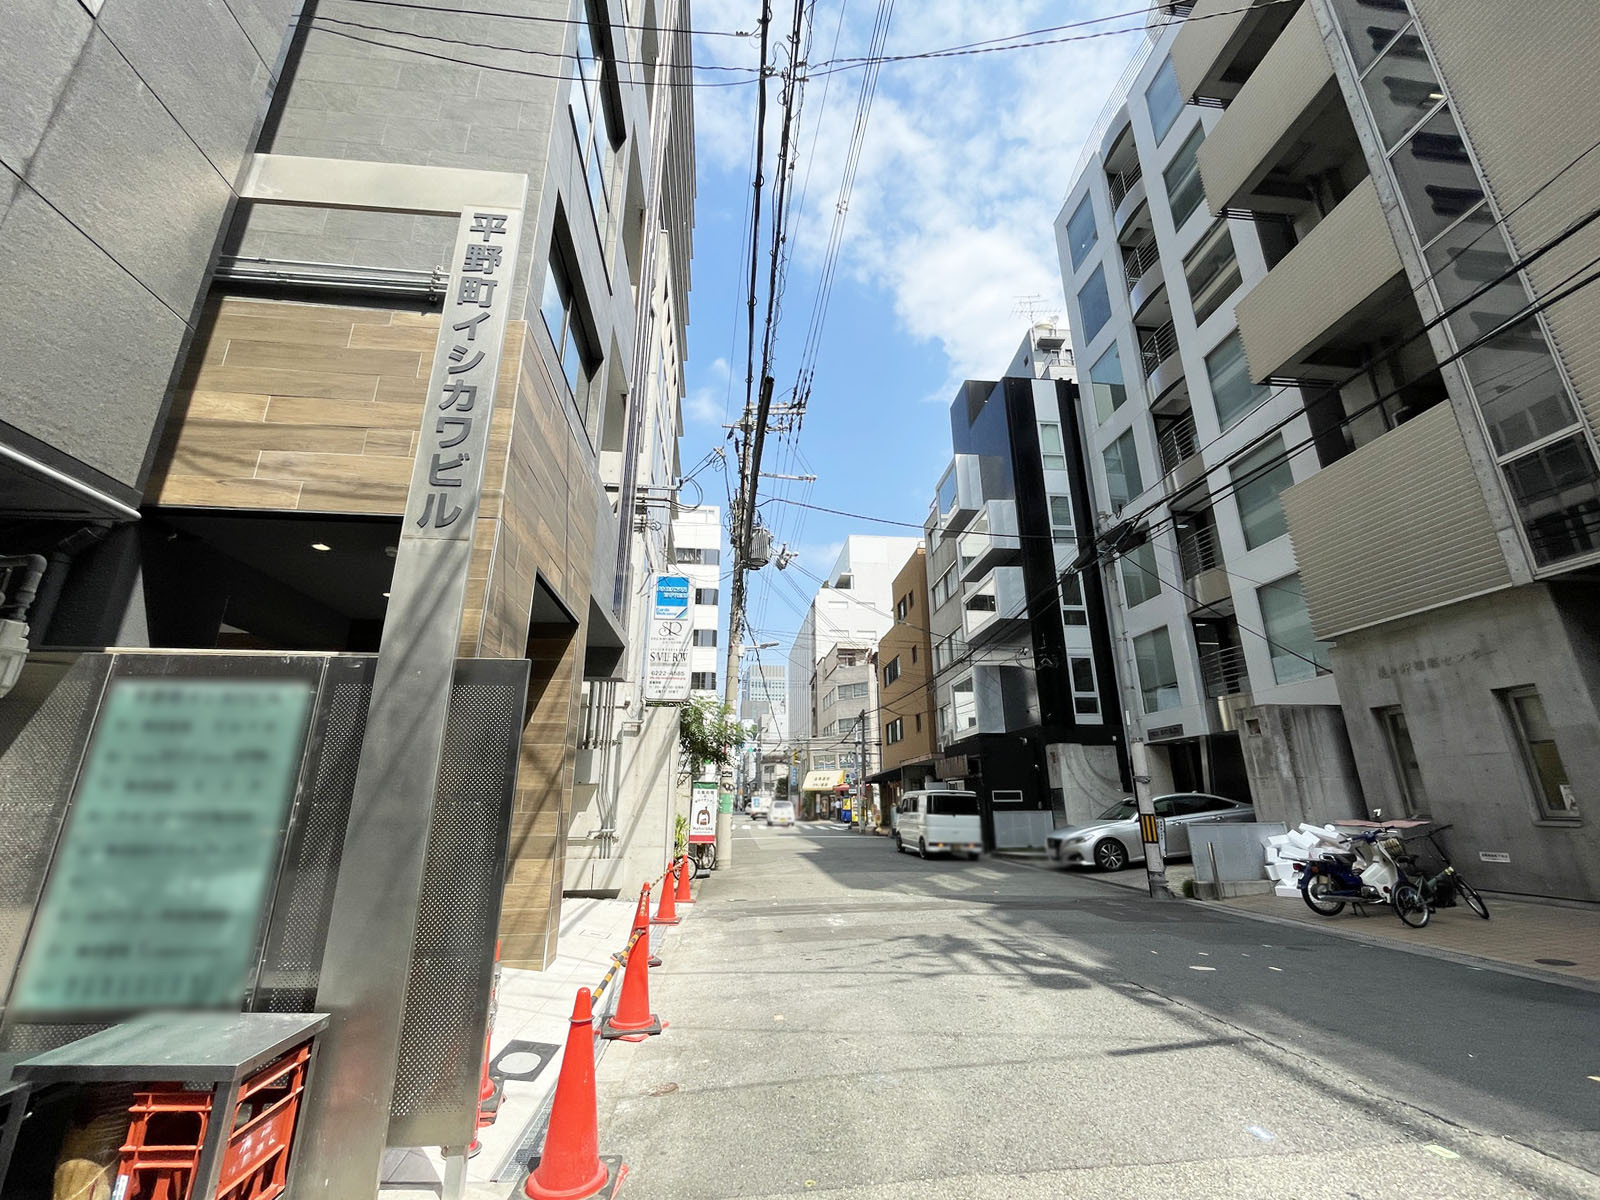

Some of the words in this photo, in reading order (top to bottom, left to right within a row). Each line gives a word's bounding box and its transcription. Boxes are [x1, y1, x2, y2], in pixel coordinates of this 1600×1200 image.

[416, 212, 508, 530] 平野町イシカワビル
